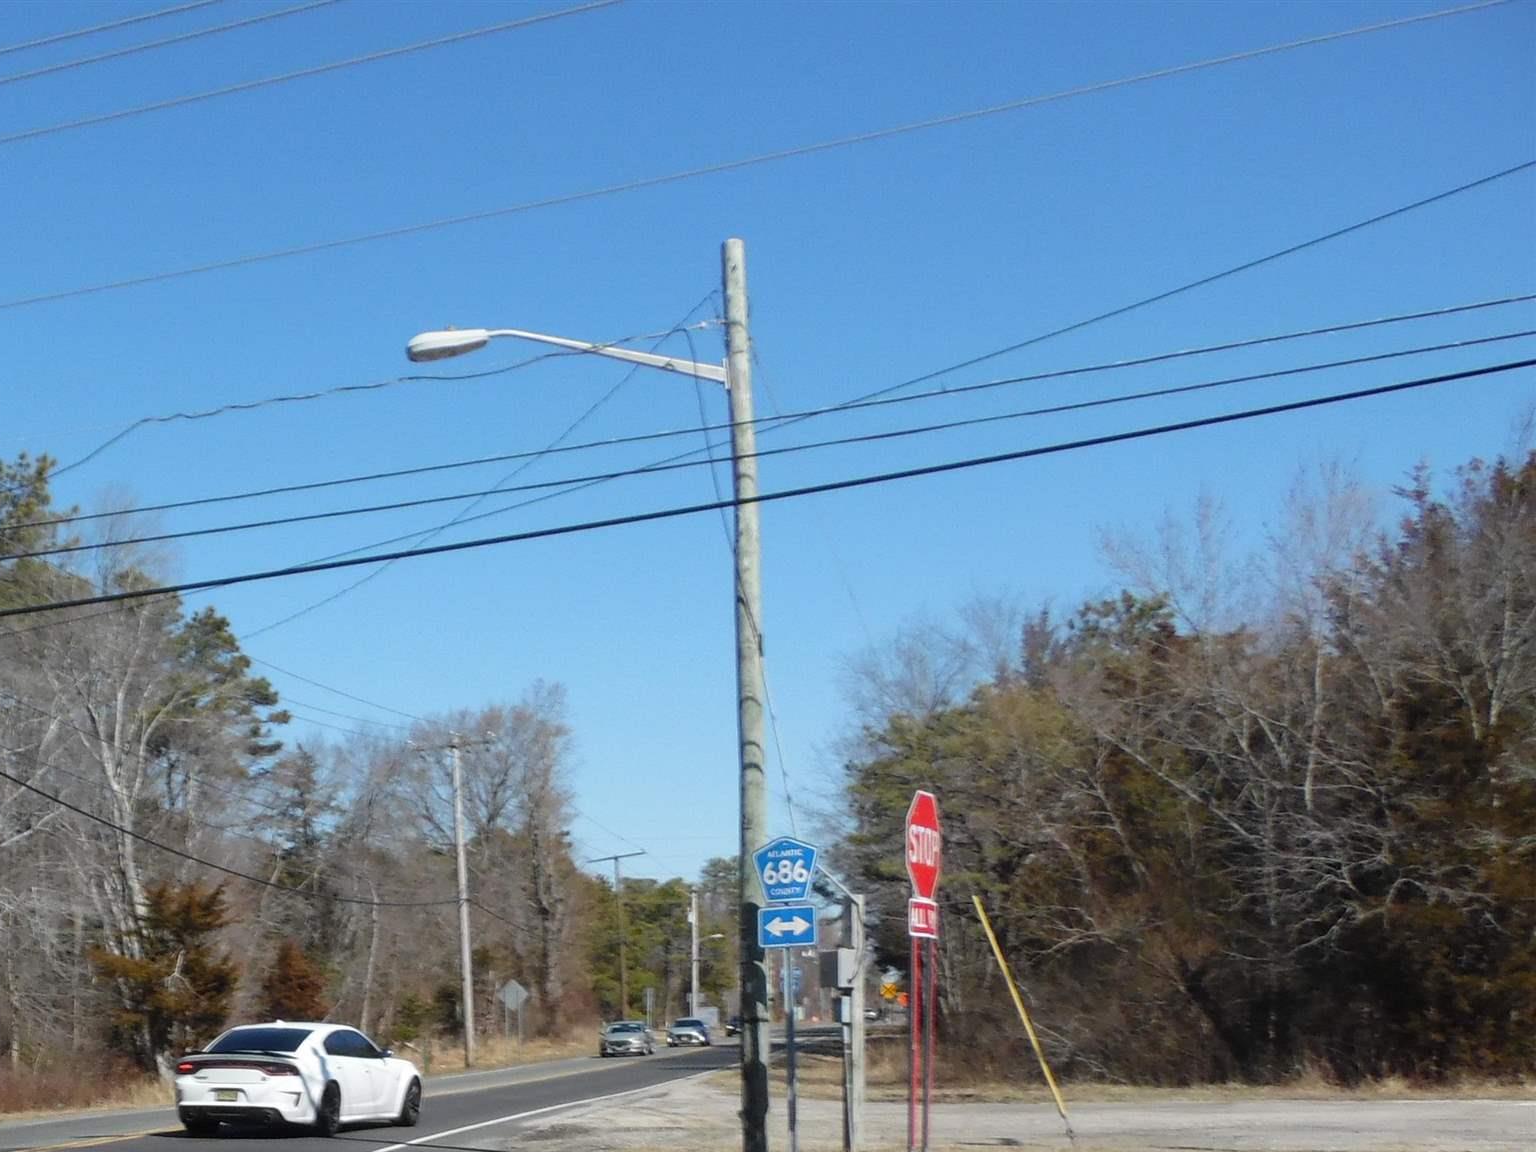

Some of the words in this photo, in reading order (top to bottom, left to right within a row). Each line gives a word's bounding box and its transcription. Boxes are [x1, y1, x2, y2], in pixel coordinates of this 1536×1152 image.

[909, 823, 940, 867] STOP
[763, 859, 809, 885] 686
[770, 886, 801, 896] COUNTY
